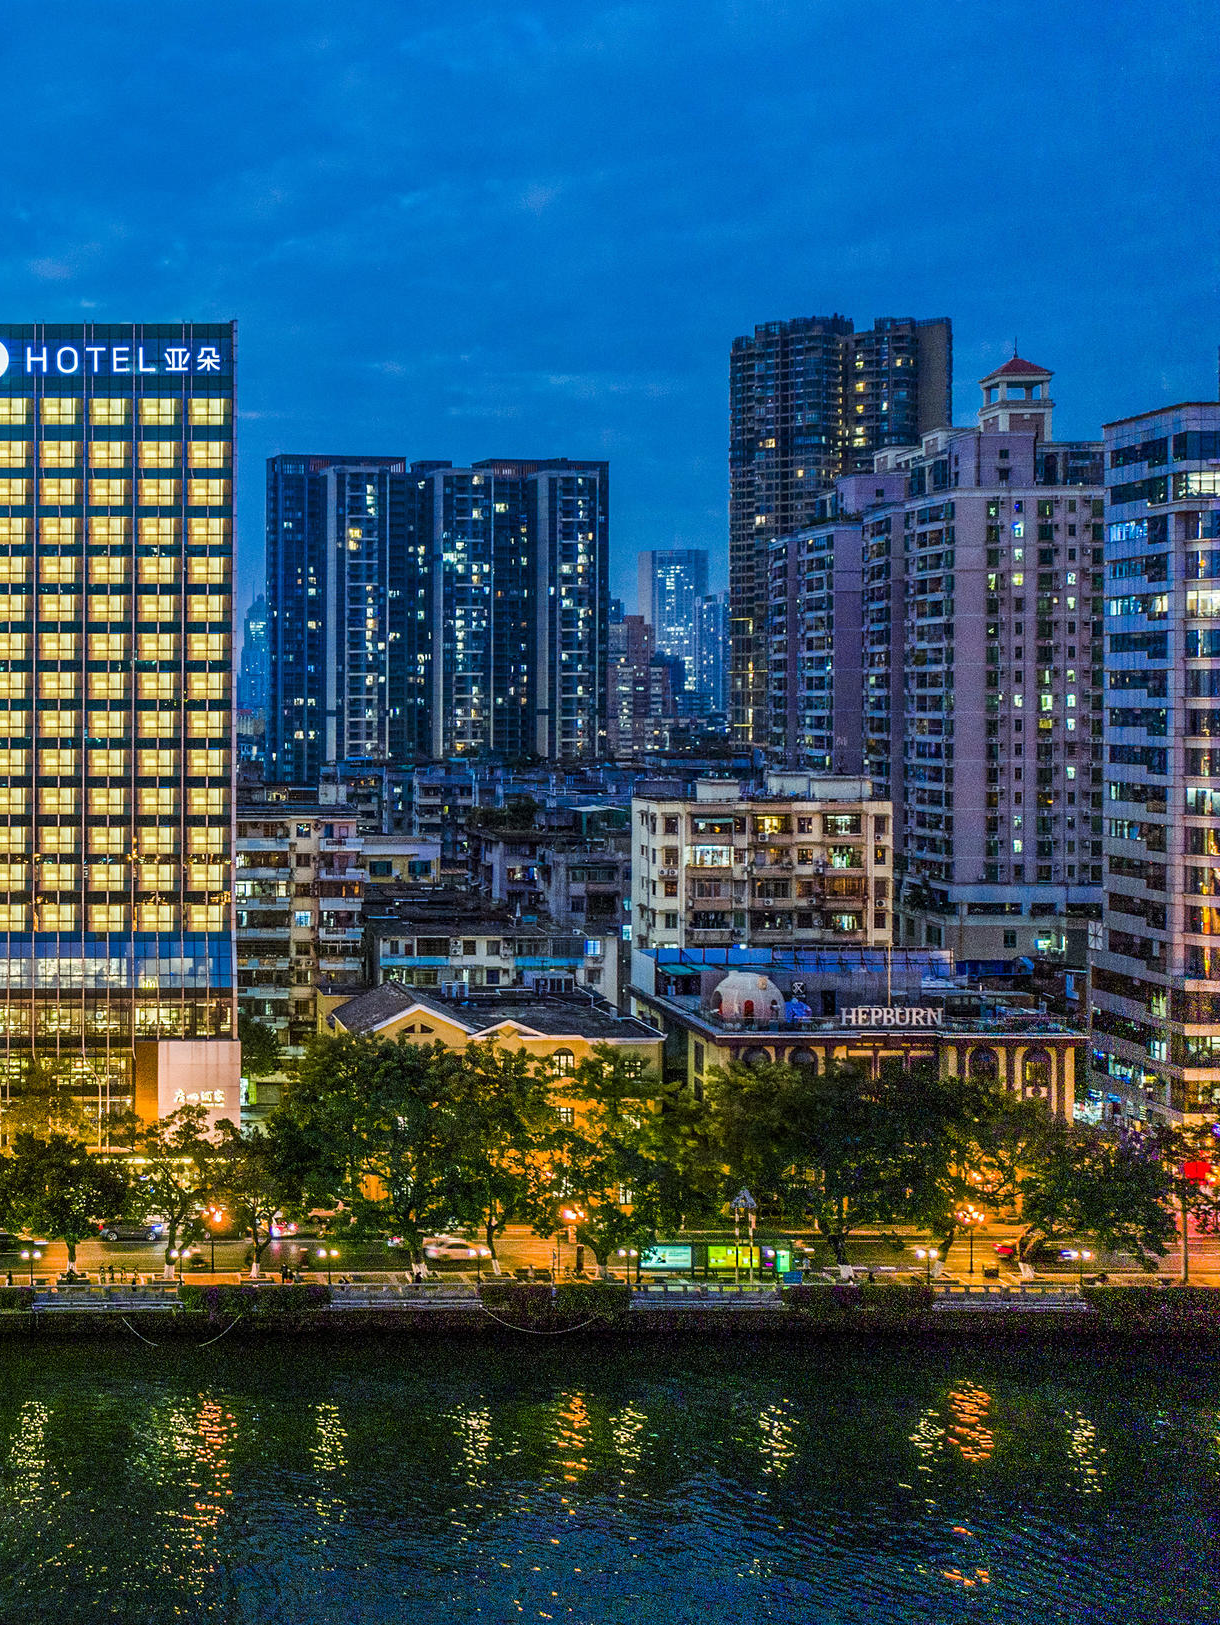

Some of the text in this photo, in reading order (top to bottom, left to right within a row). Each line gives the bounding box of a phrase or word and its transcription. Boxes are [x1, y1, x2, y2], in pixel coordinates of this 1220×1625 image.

[26, 345, 156, 373] HOTEL
[164, 346, 221, 372] 亚朵
[840, 1007, 944, 1026] HEPBURN
